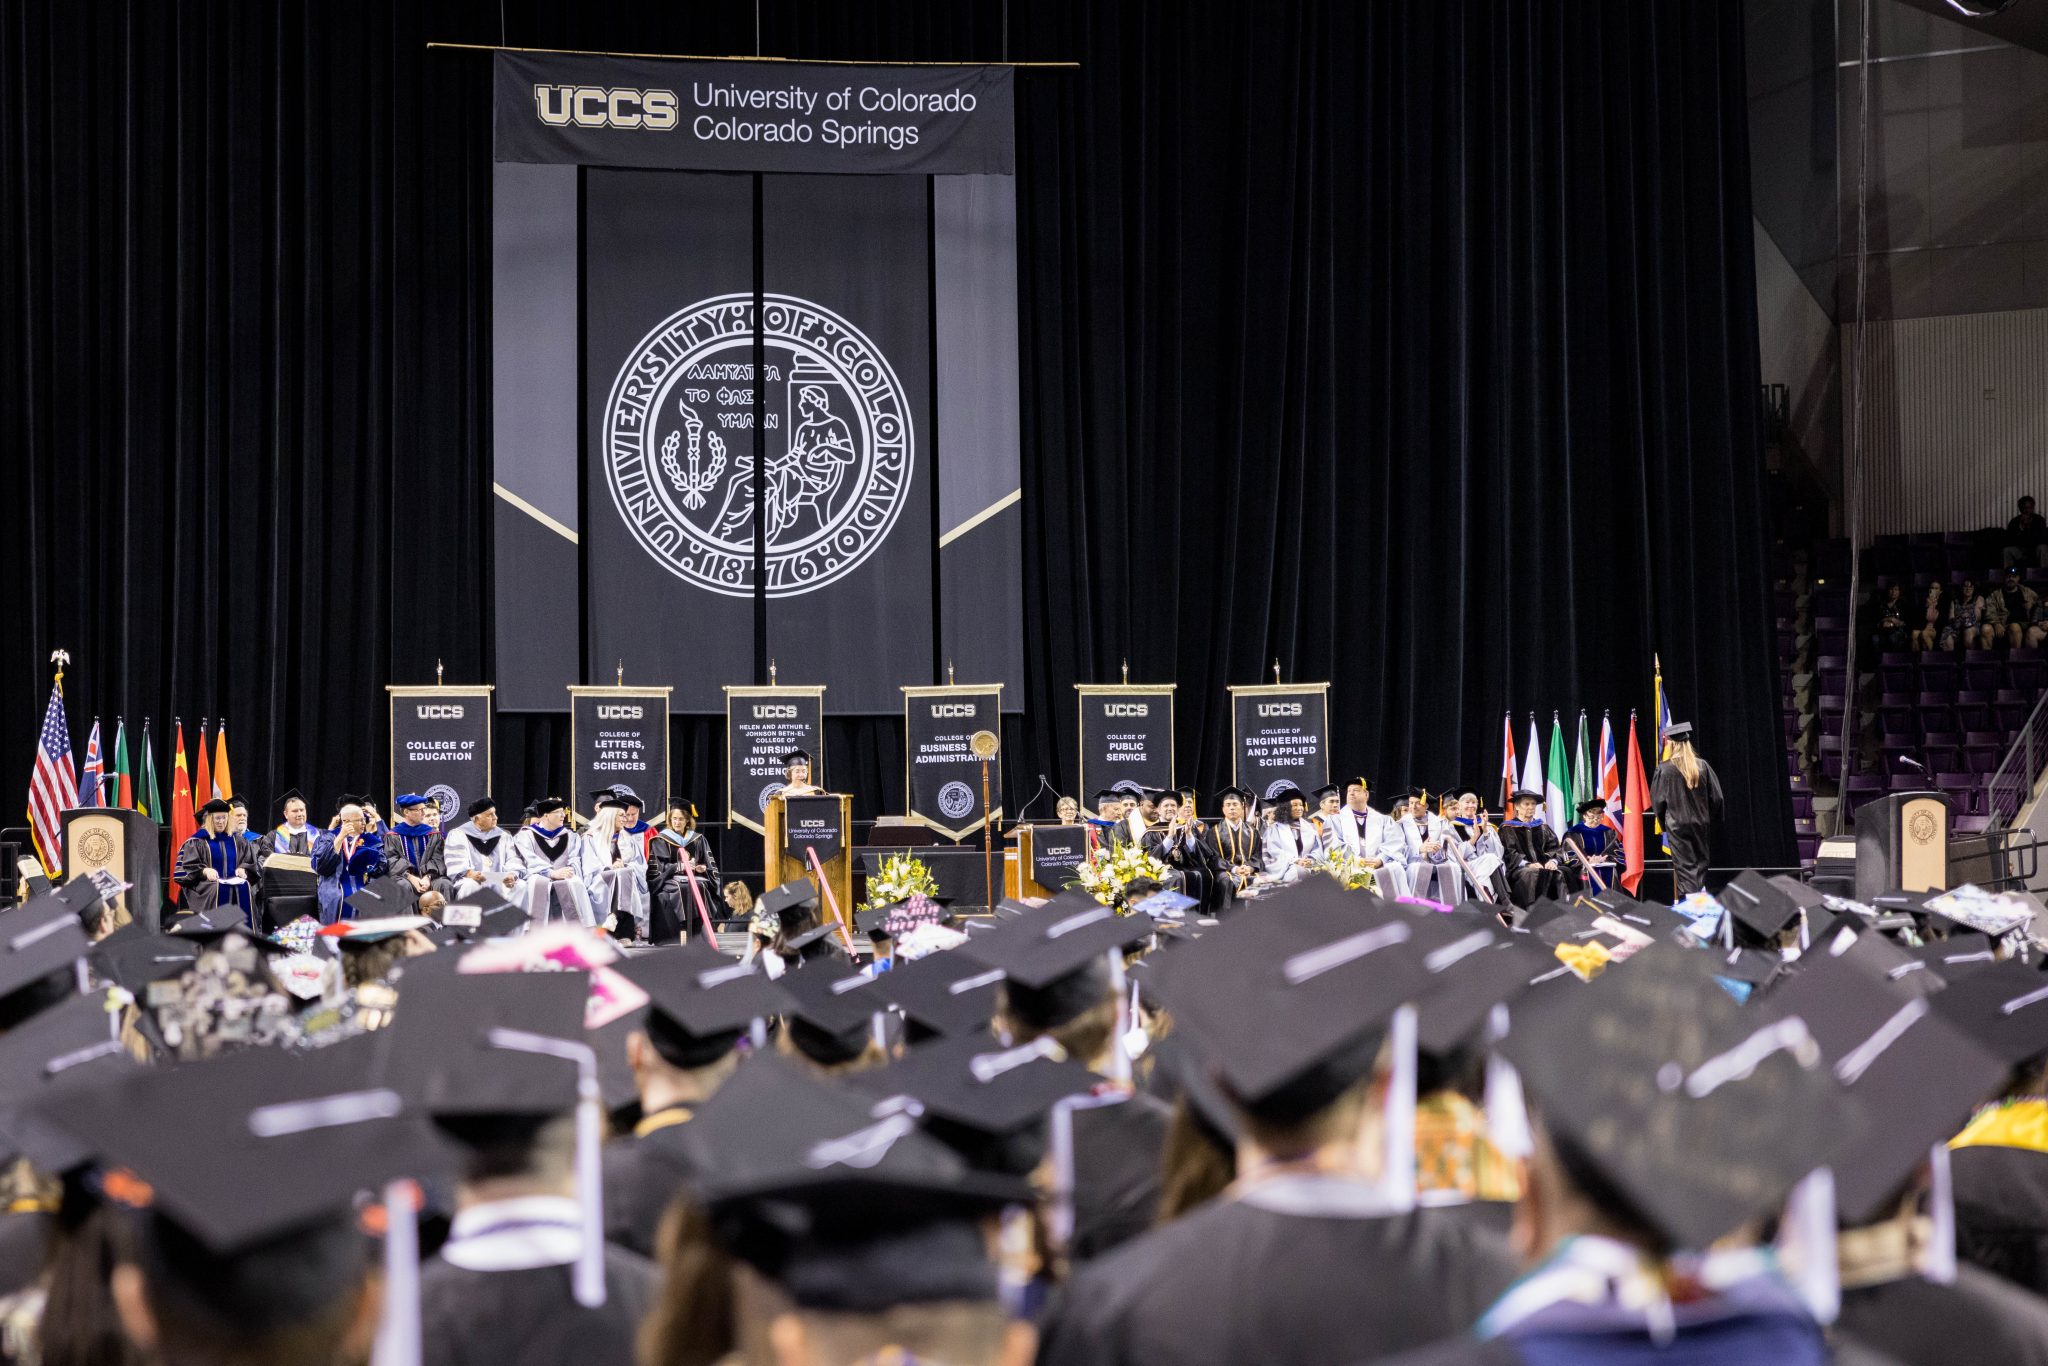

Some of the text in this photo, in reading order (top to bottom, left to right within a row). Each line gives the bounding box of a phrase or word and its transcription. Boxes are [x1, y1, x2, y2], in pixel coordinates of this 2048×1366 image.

[693, 82, 977, 115] University of Colorado
[535, 84, 679, 130] UCCS
[693, 115, 919, 151] Colorado Springs
[613, 305, 727, 556] UNIVERSITY
[833, 338, 904, 556] COLORADO
[700, 554, 817, 586] 1876
[417, 705, 464, 719] UCCS
[597, 705, 643, 720] UCCS
[753, 704, 797, 719] UCCS
[931, 703, 976, 718] UCCS
[1104, 703, 1148, 717] UCCS
[1258, 703, 1302, 717] UCCS
[406, 741, 475, 750] COLLEGE OF
[595, 740, 645, 750] LETTERS,
[1246, 735, 1317, 746] ENGINEERING
[920, 744, 967, 752] BUSINESS
[1109, 742, 1144, 751] PUBLIC
[1247, 746, 1316, 756] AND APPLIED
[409, 752, 472, 761] EDUCATION
[600, 751, 639, 760] ARTS &
[1106, 752, 1147, 761] SERVICE
[744, 757, 765, 765] AND
[1259, 757, 1305, 767] SCIENCE
[593, 762, 646, 771] SCIENCES
[1047, 847, 1071, 855] UCCS
